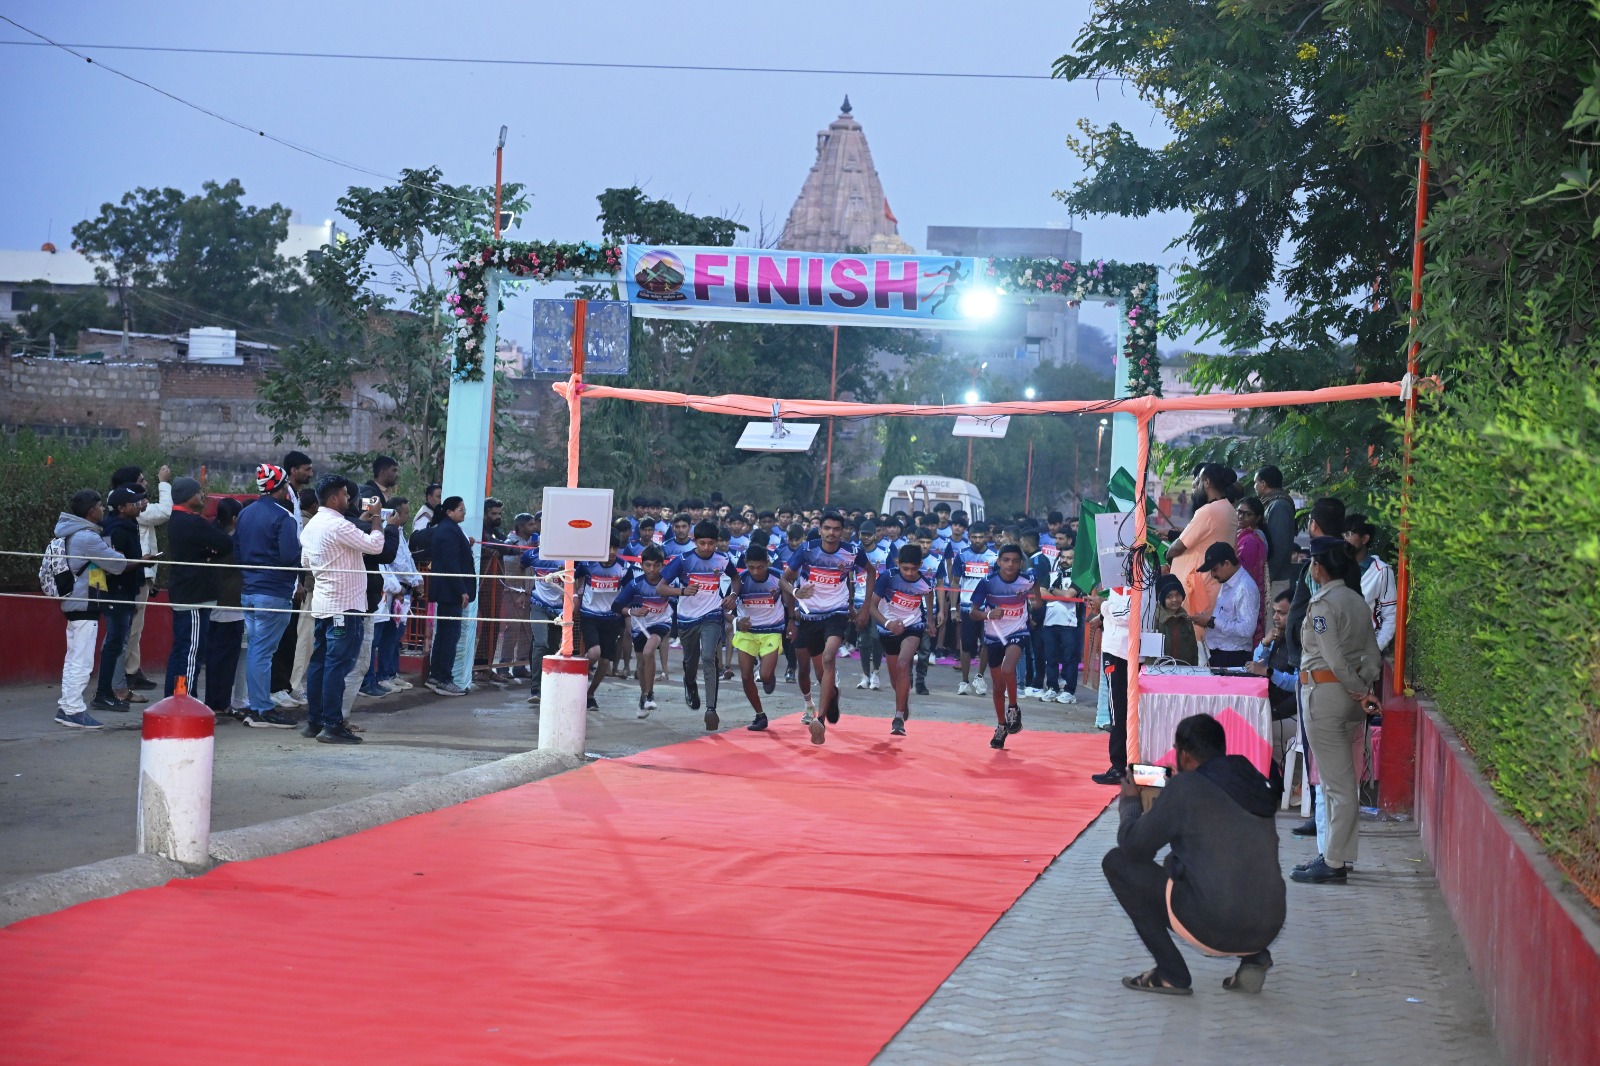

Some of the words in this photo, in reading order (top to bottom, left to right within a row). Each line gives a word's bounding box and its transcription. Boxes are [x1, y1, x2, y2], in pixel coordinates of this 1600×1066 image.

[694, 253, 919, 311] FINISH
[814, 575, 836, 584] 1073
[694, 582, 714, 590] 077
